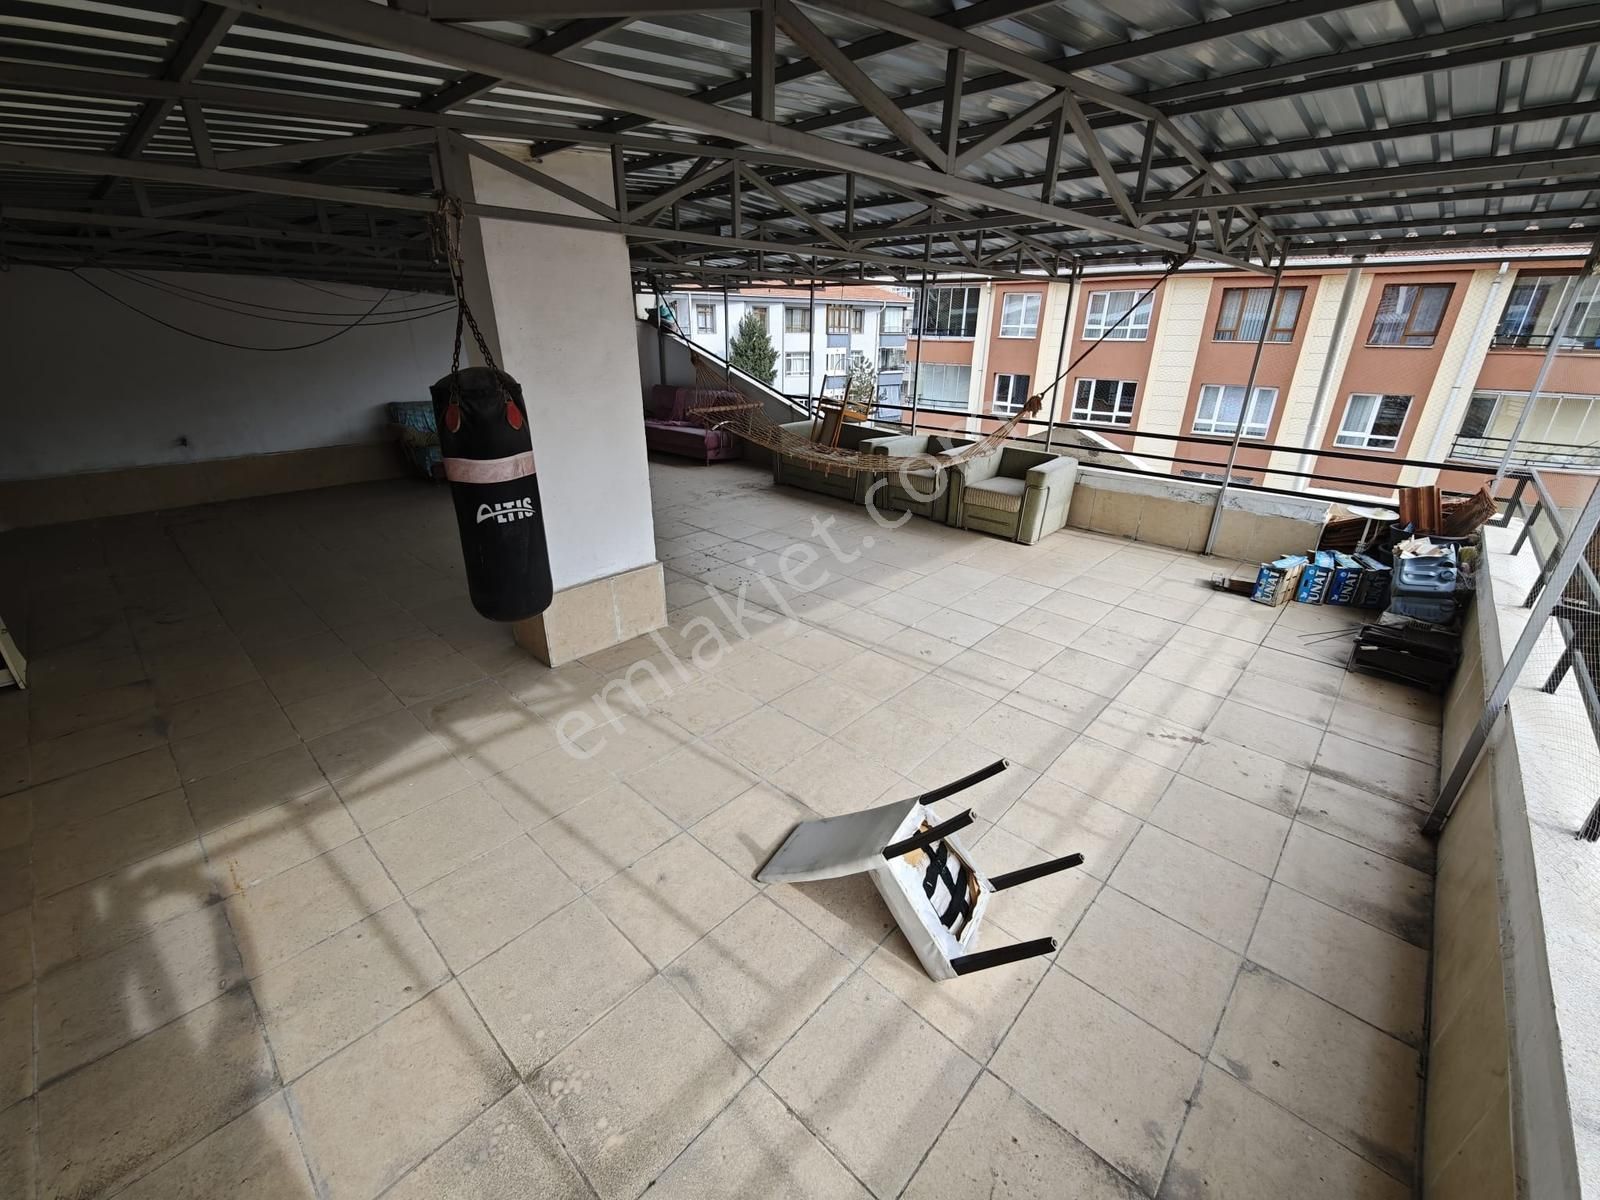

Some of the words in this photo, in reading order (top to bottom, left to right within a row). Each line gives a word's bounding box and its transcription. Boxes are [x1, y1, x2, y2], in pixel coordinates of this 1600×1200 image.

[477, 497, 535, 524] ALTIS
[1308, 570, 1328, 602] UNAT
[1339, 571, 1359, 602] UNAT
